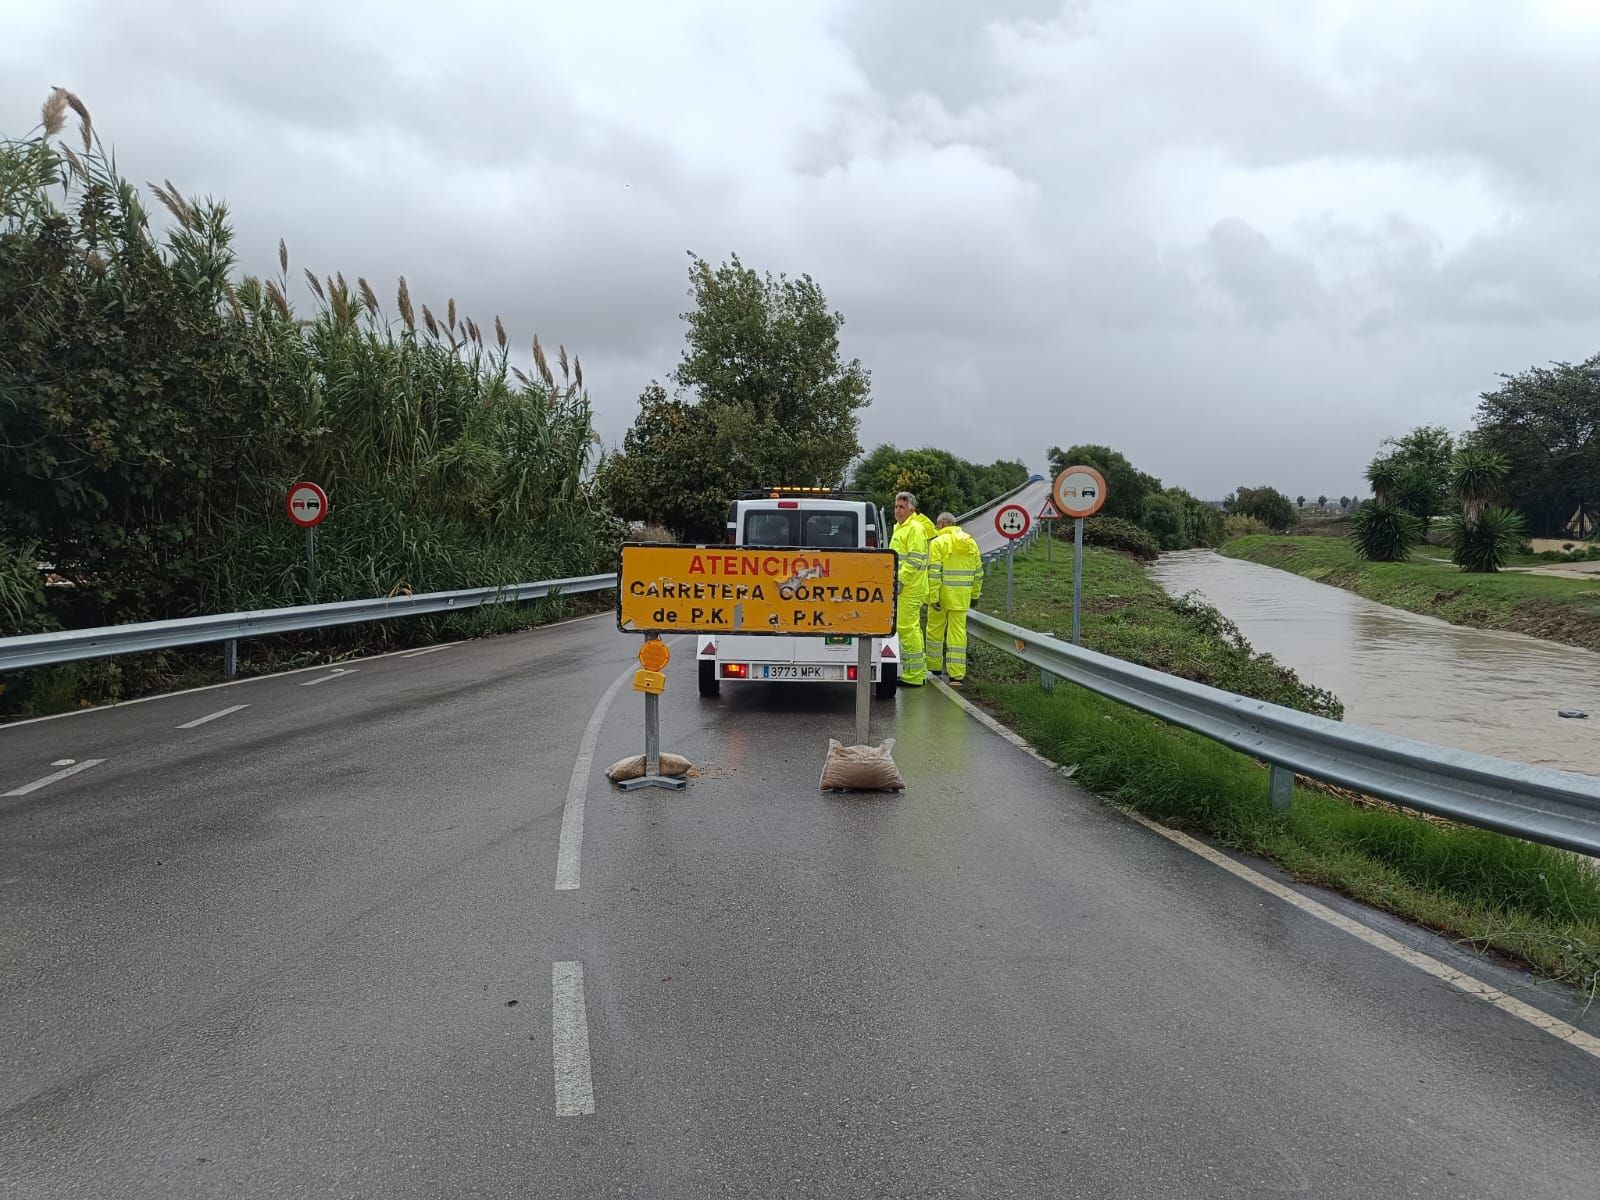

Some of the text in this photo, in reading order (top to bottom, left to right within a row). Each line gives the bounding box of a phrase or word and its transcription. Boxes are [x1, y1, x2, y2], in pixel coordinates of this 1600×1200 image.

[688, 554, 831, 577] ATENCIÓN
[630, 581, 884, 603] CARRETERA CORTADA
[653, 608, 677, 623] de
[691, 608, 728, 624] P.K.
[794, 610, 832, 626] P.K.
[771, 666, 797, 677] 3773
[801, 667, 821, 677] MPK
